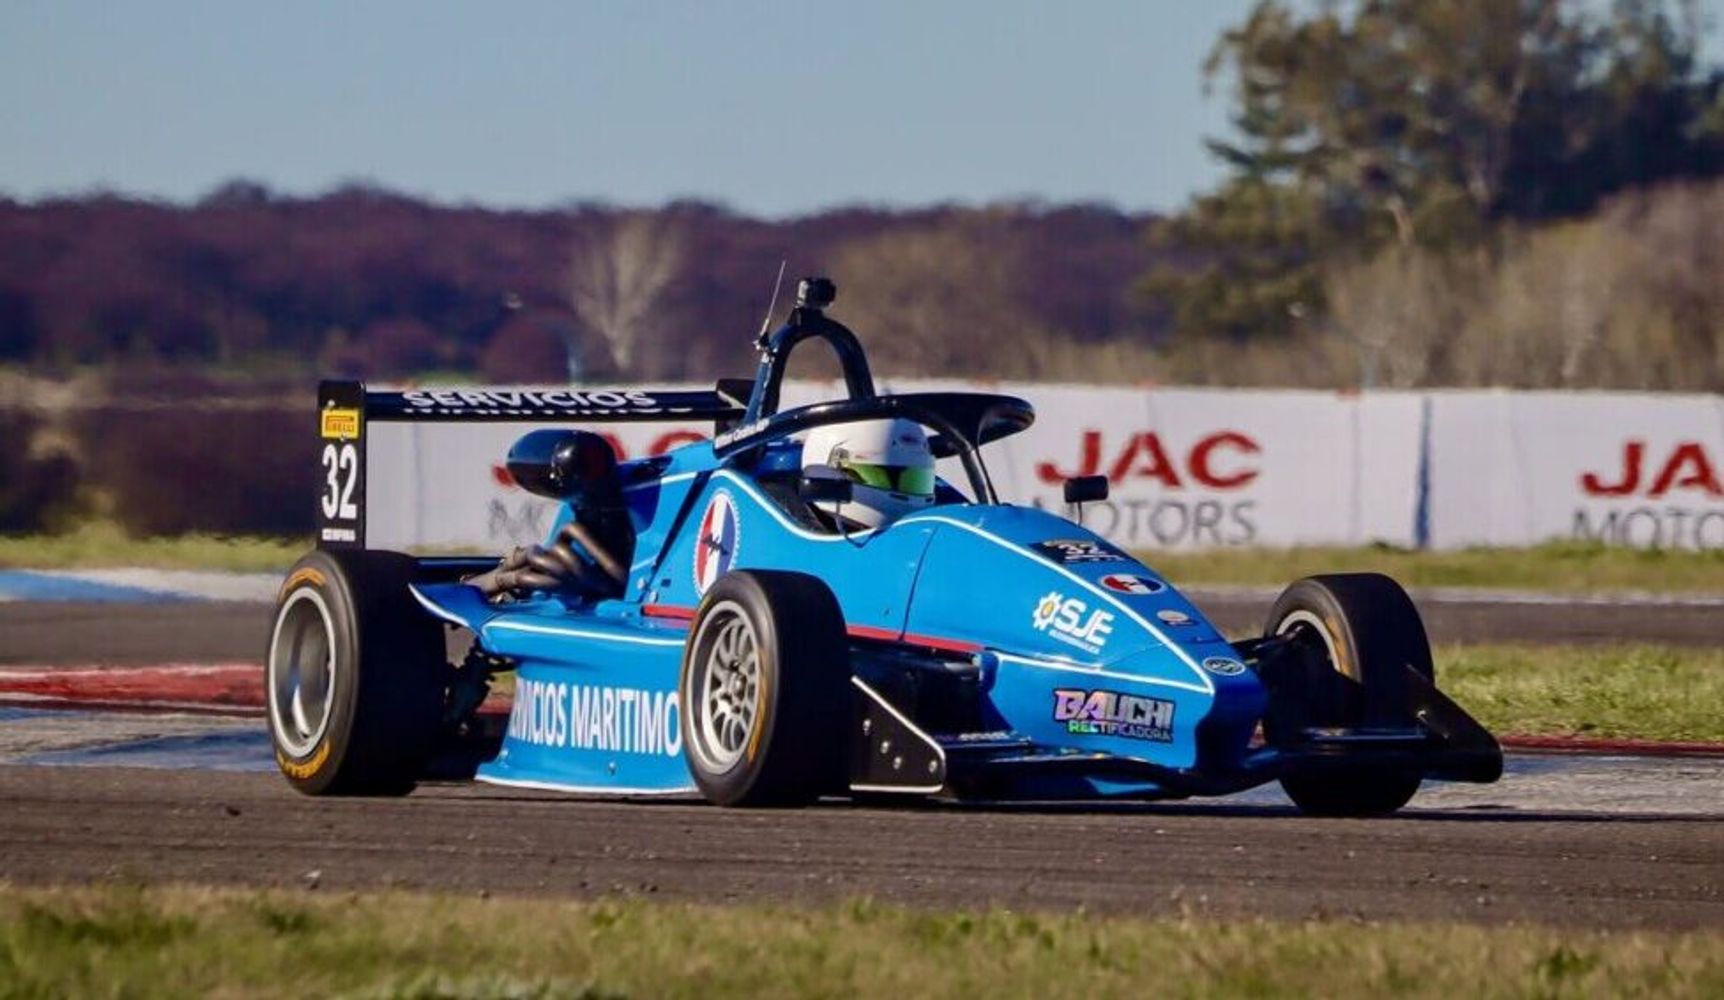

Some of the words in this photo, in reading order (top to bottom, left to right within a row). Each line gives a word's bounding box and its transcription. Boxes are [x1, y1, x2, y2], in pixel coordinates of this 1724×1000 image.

[402, 391, 656, 407] SERVICIOS
[321, 443, 357, 519] 32
[1036, 432, 1262, 489] JAC
[1033, 497, 1257, 545] OTORS
[1054, 598, 1115, 646] SJE
[571, 684, 683, 757] MARITIMO
[1054, 690, 1174, 729] BAUCHI
[1068, 719, 1171, 740] RECTIFICADORA
